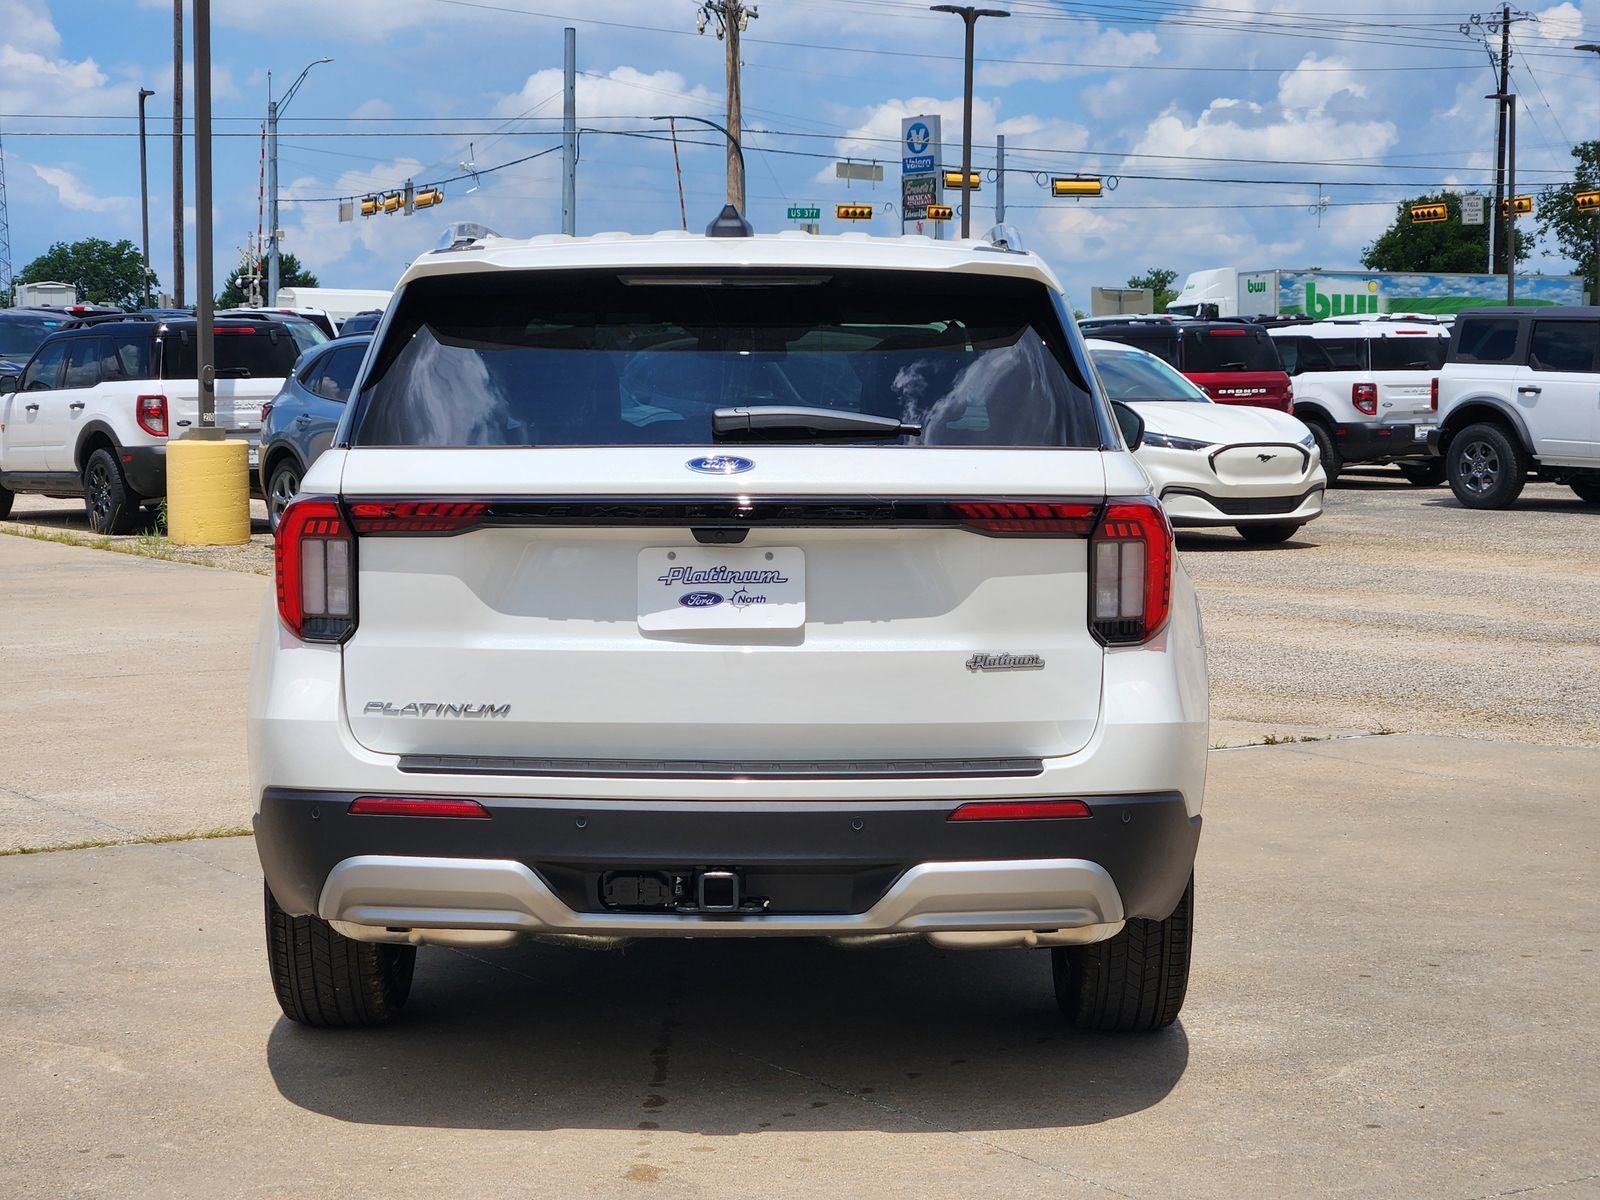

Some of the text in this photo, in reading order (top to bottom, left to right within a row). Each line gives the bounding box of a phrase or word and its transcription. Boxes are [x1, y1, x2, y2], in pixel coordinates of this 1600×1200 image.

[905, 158, 932, 169] Valero
[907, 193, 932, 201] MEXICAN
[791, 209, 817, 217] US 377
[1247, 278, 1266, 293] bwi
[1305, 280, 1379, 320] bwi
[657, 565, 788, 586] Platinum
[687, 594, 767, 606] Ford North
[966, 652, 1045, 670] Platinum
[363, 701, 511, 718] PLATINUM
